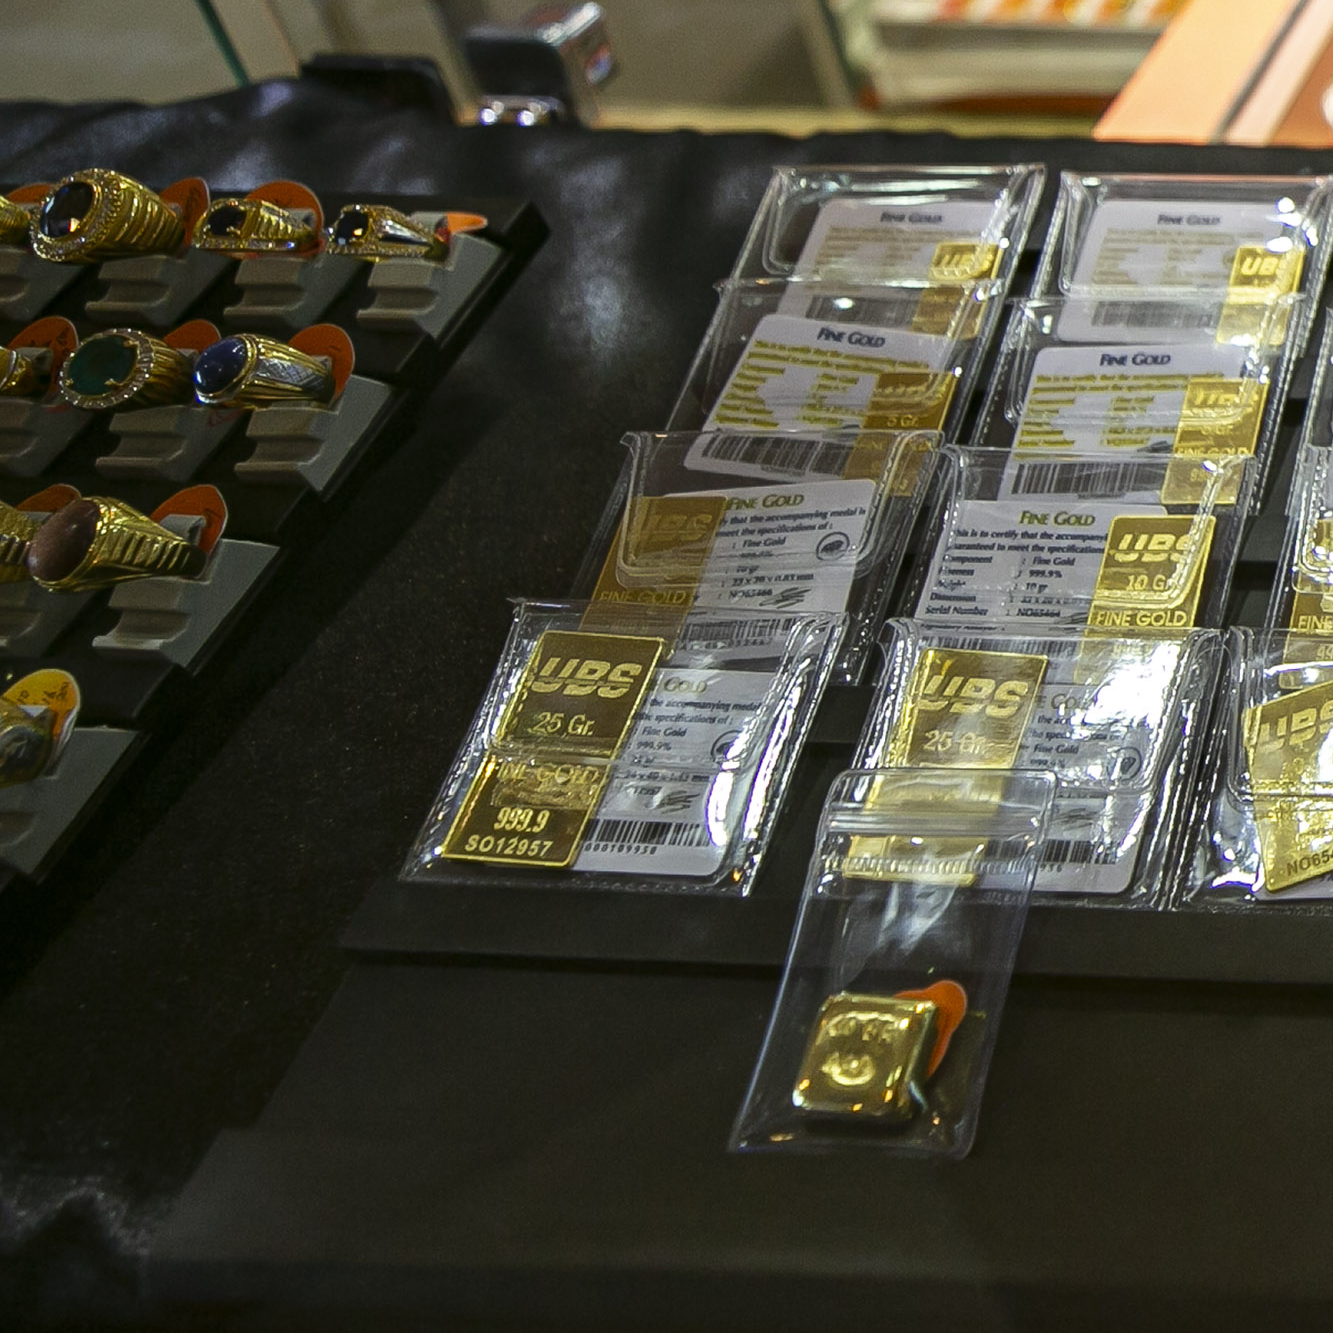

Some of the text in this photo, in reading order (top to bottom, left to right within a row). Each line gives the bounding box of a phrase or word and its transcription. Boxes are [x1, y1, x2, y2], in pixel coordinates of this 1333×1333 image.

[817, 327, 886, 348] FINE GOLD
[1099, 353, 1172, 366] FINE GOLD
[762, 493, 805, 509] GOLD
[1019, 511, 1096, 527] FINE GOLD
[1033, 556, 1077, 566] Fine Gold
[1126, 574, 1148, 592] 10
[1095, 610, 1188, 628] FINE GOLD
[530, 657, 643, 699] UBS
[916, 674, 1029, 717] UBS
[532, 712, 596, 737] 25 Gr.
[663, 727, 688, 738] Gold
[493, 807, 550, 834] 999.9
